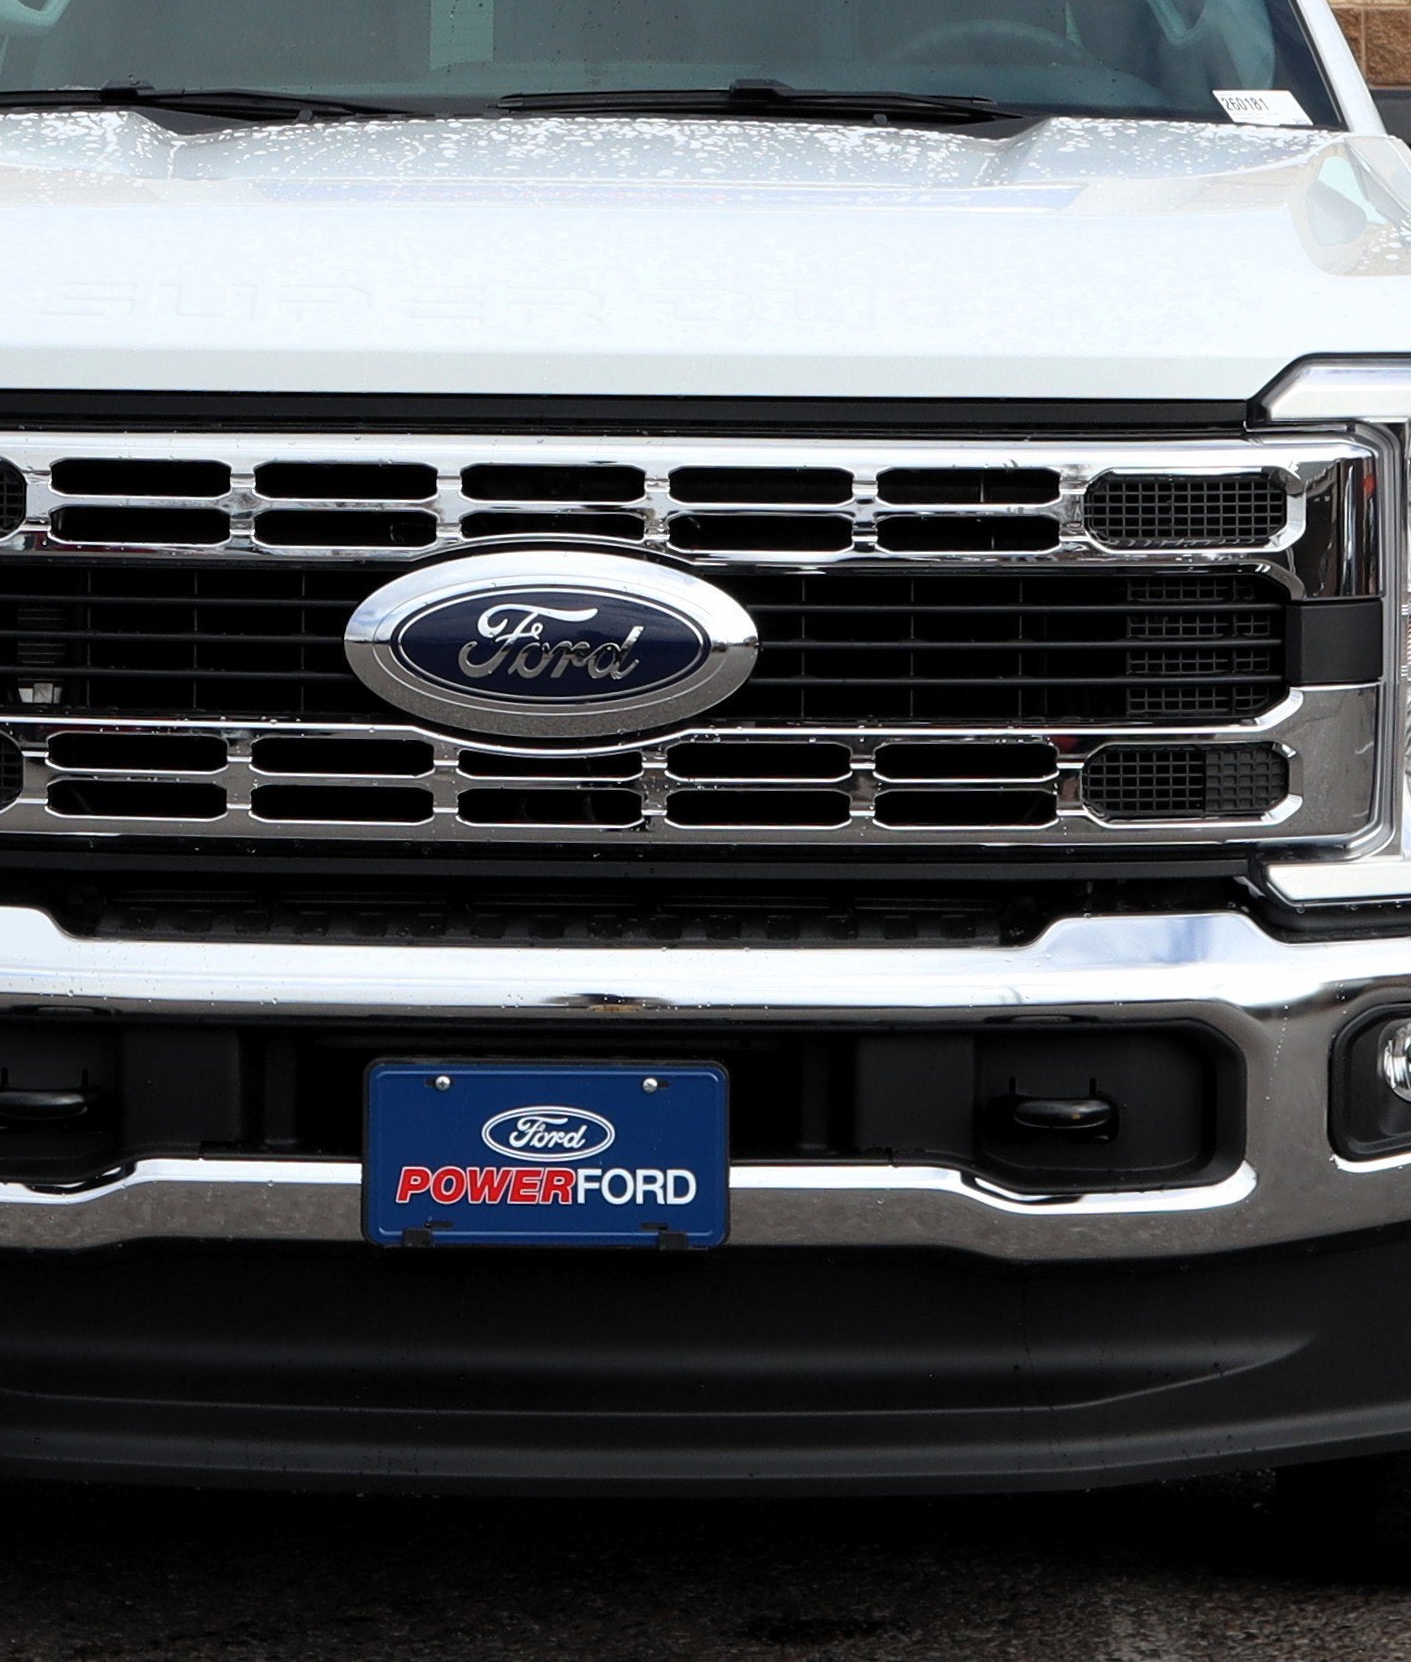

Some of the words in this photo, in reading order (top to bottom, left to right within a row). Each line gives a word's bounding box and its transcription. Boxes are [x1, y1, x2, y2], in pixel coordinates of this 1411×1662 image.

[1221, 96, 1269, 112] 260181
[458, 603, 645, 681] Ford
[508, 1114, 589, 1151] Ford
